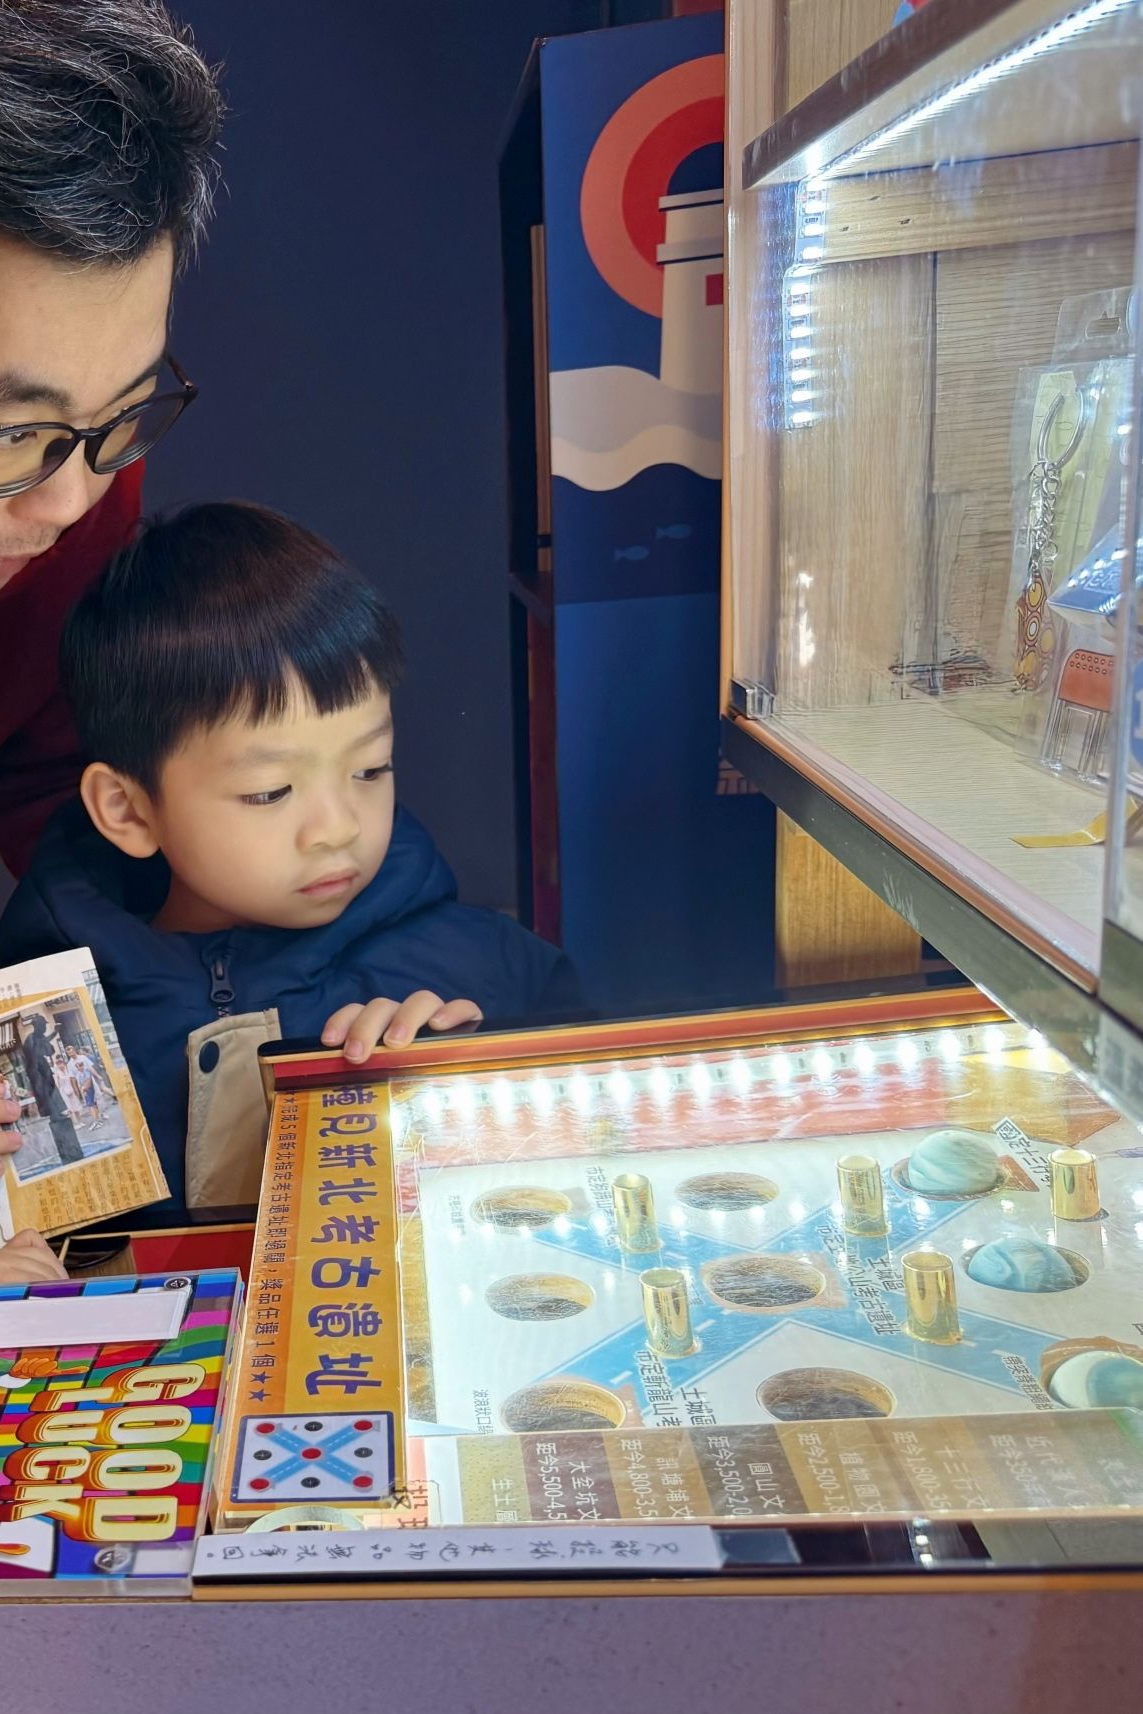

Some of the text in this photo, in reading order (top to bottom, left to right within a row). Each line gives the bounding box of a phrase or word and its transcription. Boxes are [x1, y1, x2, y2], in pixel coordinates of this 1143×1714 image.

[305, 1086, 383, 1395] 撞見新北考古遺址
[61, 1363, 206, 1541] GOOD
[747, 1462, 786, 1511] 圓山文
